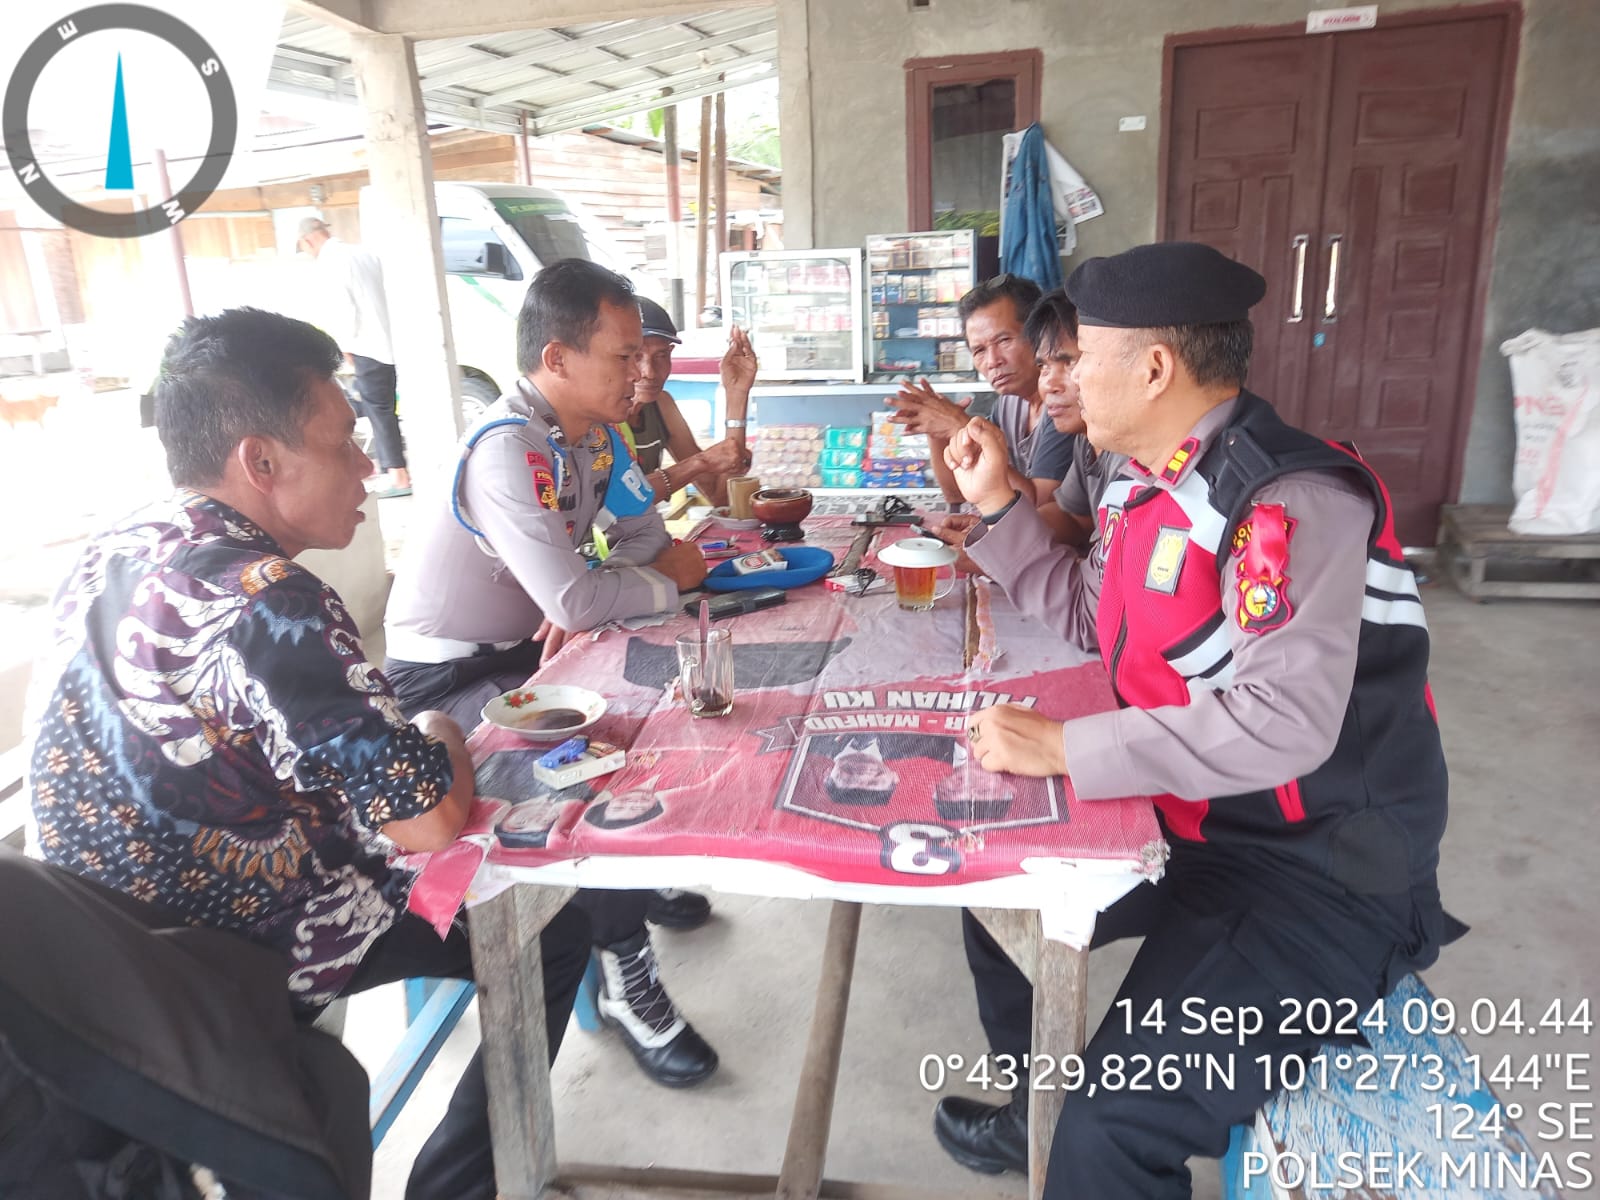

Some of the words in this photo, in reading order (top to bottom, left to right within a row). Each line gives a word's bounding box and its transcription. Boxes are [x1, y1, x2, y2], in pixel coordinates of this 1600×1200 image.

[822, 690, 876, 709] KU
[887, 690, 1037, 710] PILIHAN
[804, 713, 920, 731] MAHFUD
[889, 823, 950, 876] 3
